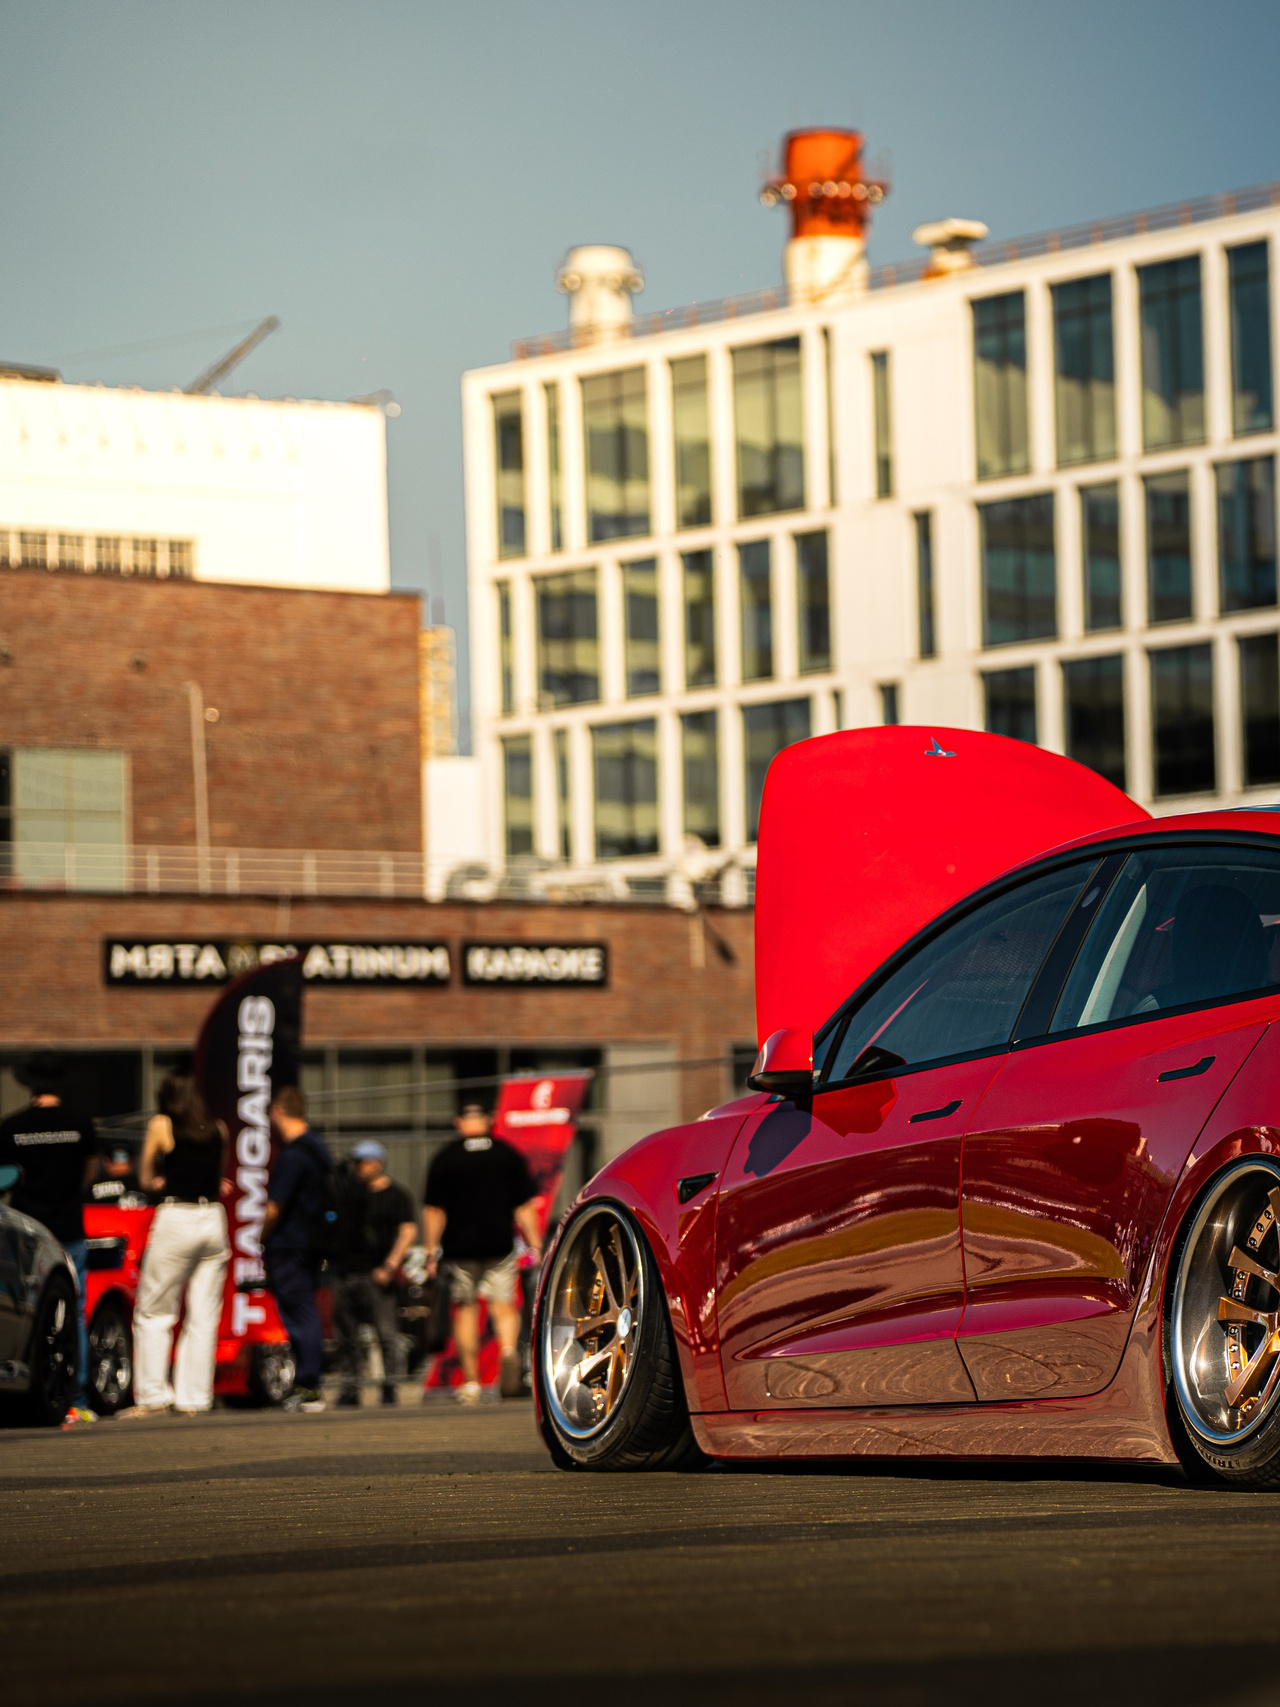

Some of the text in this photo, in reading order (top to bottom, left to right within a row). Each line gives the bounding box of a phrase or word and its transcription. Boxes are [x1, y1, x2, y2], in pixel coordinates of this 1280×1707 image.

[110, 944, 227, 979] МЯТА
[260, 944, 450, 979] PATINUM
[467, 946, 602, 980] КАРАОКЕ
